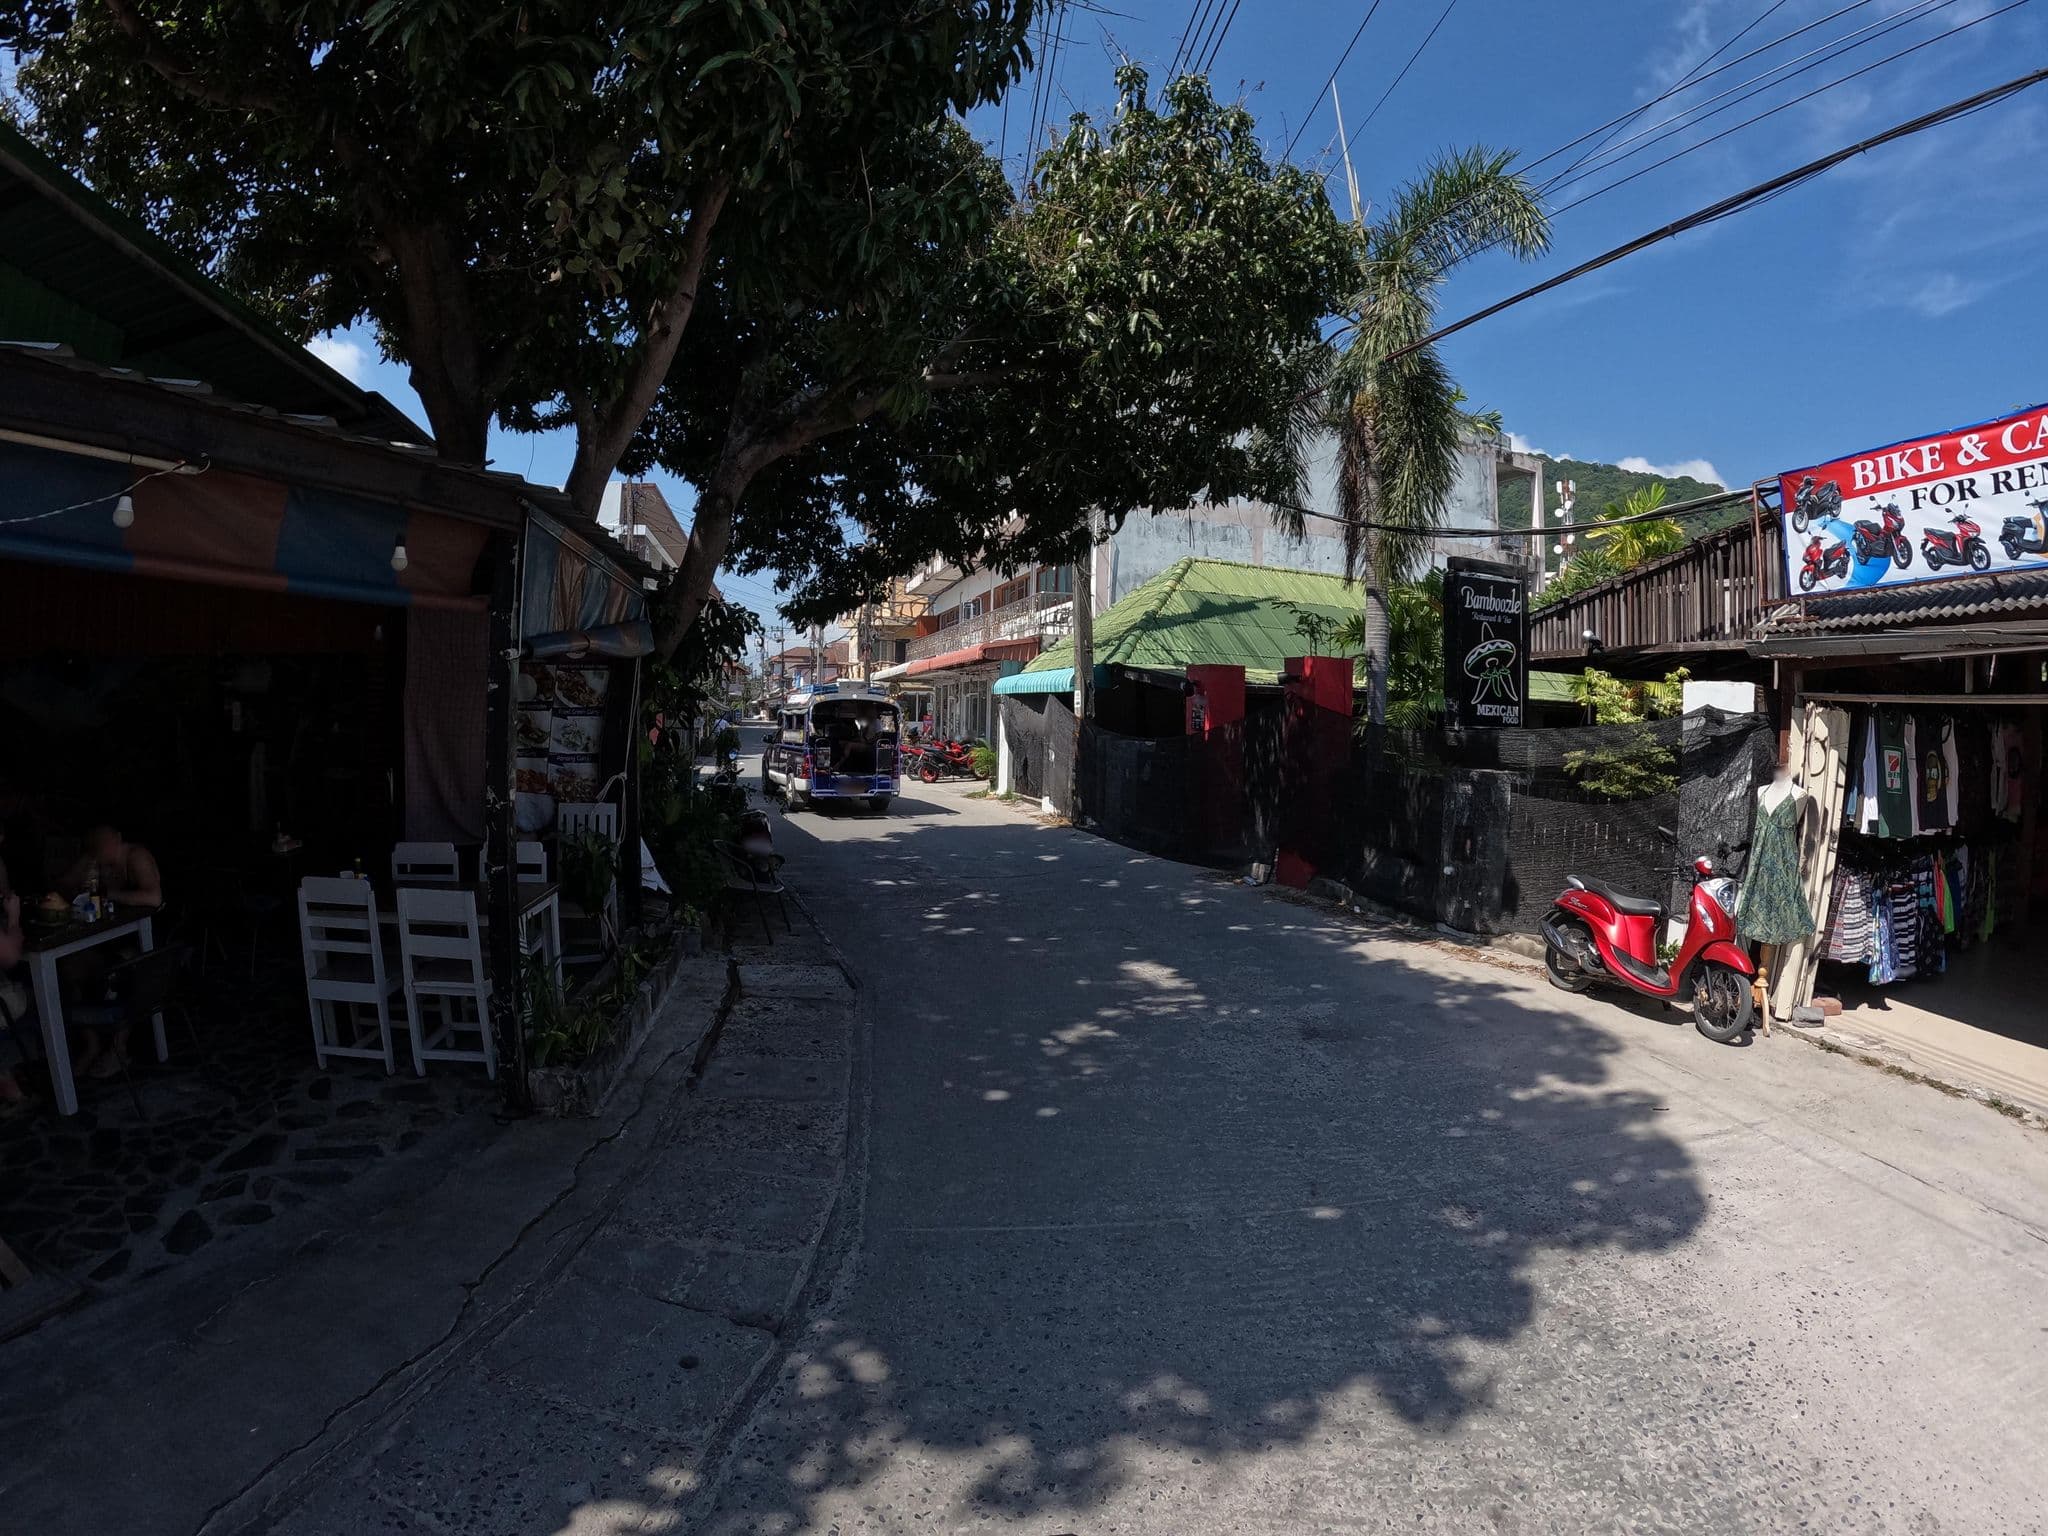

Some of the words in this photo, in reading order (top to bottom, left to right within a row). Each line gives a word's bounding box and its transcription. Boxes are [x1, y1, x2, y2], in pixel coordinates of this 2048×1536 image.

[1851, 443, 1945, 491] BIKE
[1957, 433, 1991, 466] &
[1911, 477, 1981, 511] FOR
[1461, 585, 1521, 615] Bamboozle
[1477, 703, 1519, 717] MEXICAN
[1502, 716, 1519, 724] FOOD
